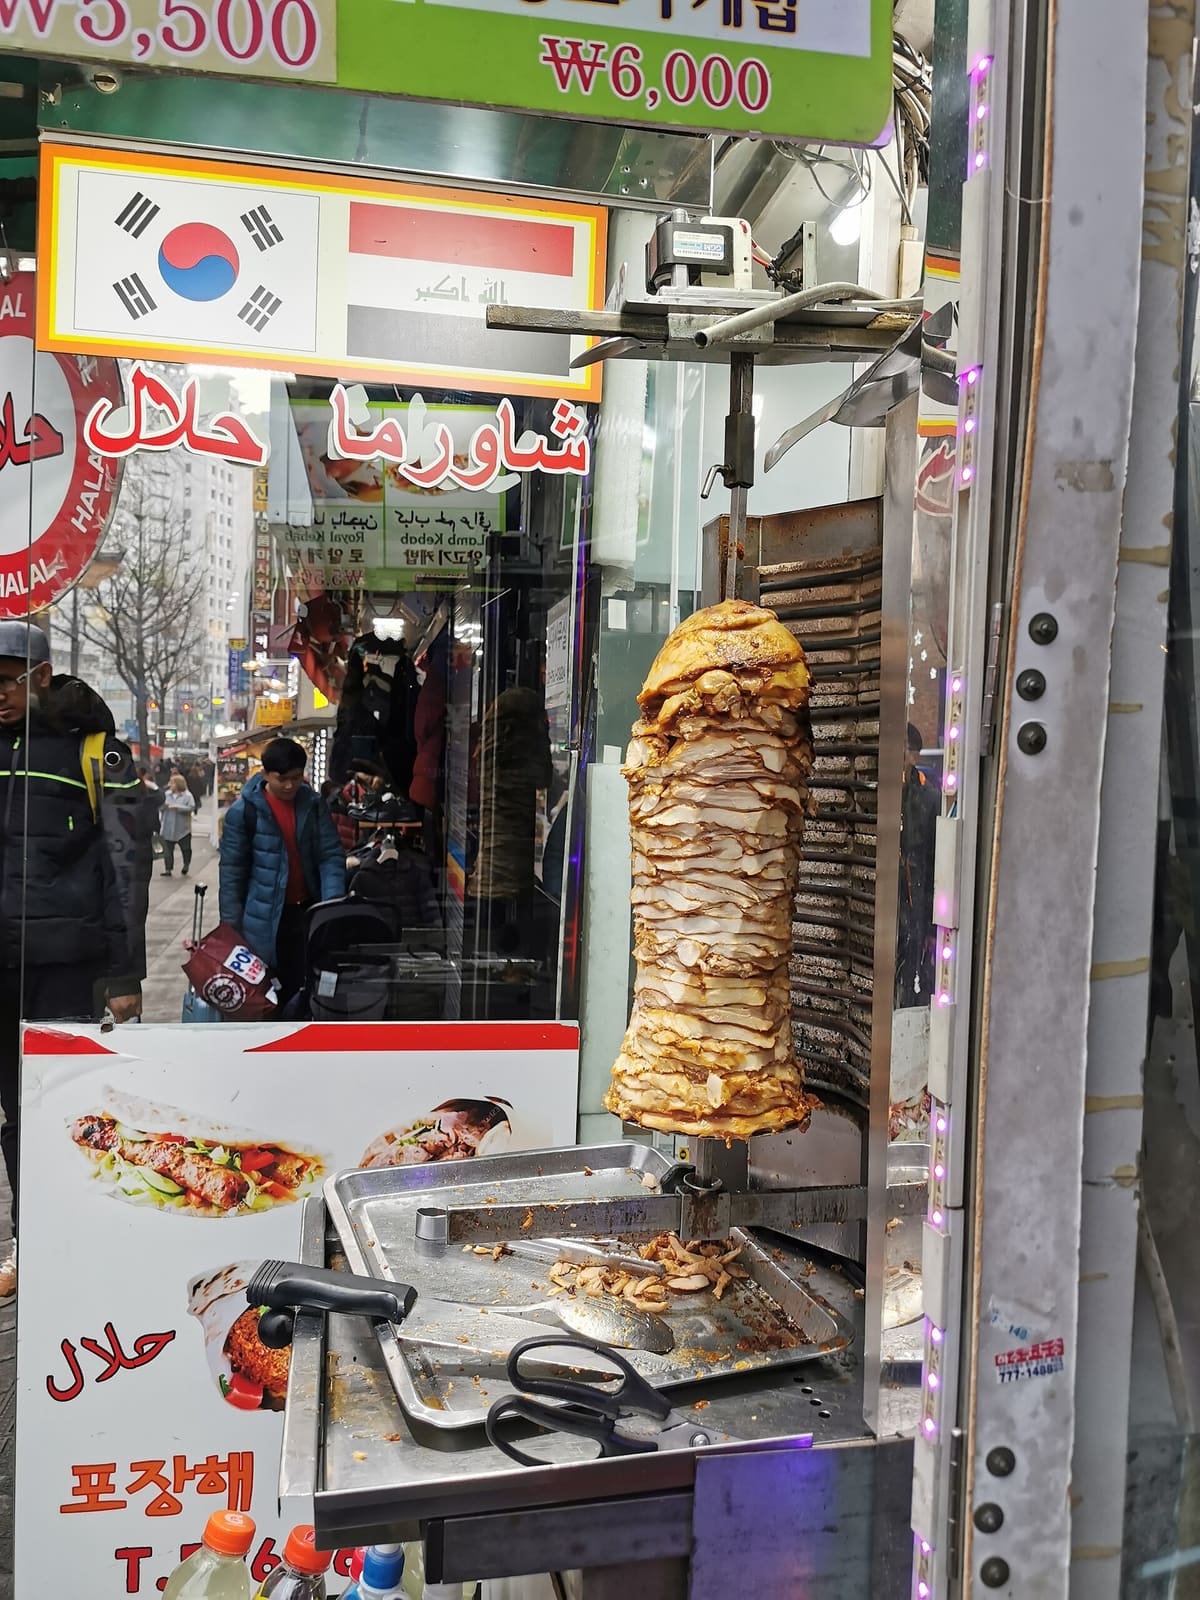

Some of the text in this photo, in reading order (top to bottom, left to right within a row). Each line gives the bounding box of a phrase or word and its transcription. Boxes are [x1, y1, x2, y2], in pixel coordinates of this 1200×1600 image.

[86, 366, 588, 489] شاورما حلال
[71, 453, 104, 534] HALA
[0, 558, 54, 598] ALAL
[46, 1322, 176, 1402] حلال
[59, 1451, 255, 1517] 포장해
